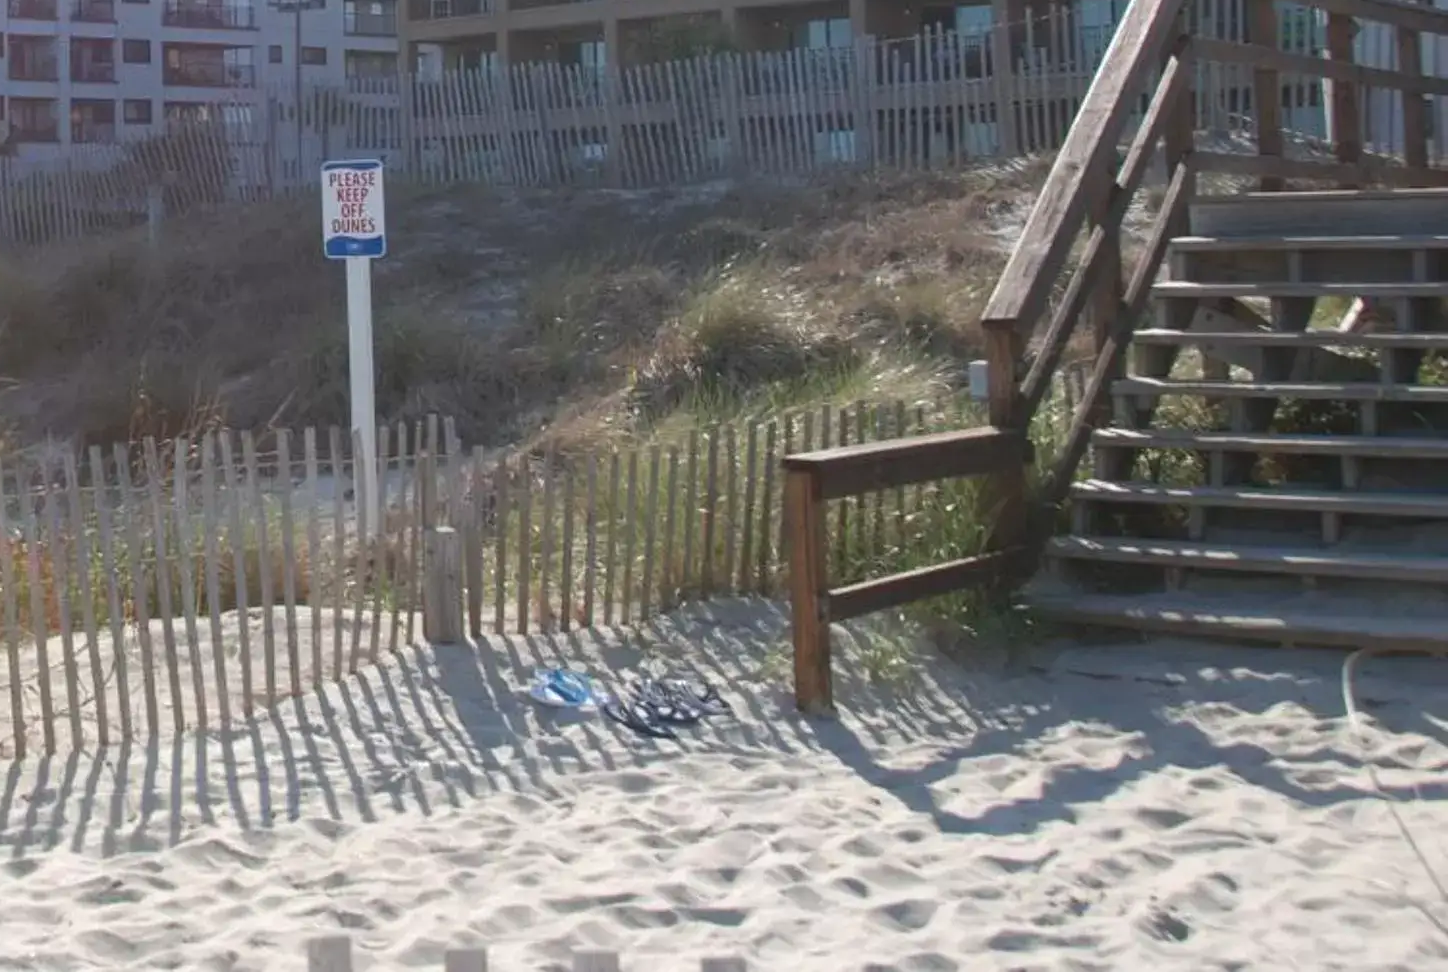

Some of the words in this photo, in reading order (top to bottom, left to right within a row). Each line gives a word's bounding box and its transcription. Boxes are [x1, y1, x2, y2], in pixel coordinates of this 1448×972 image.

[329, 171, 376, 187] PLEASE
[337, 188, 369, 202] KEEP
[341, 203, 365, 218] OFF
[332, 218, 375, 234] DUNES
